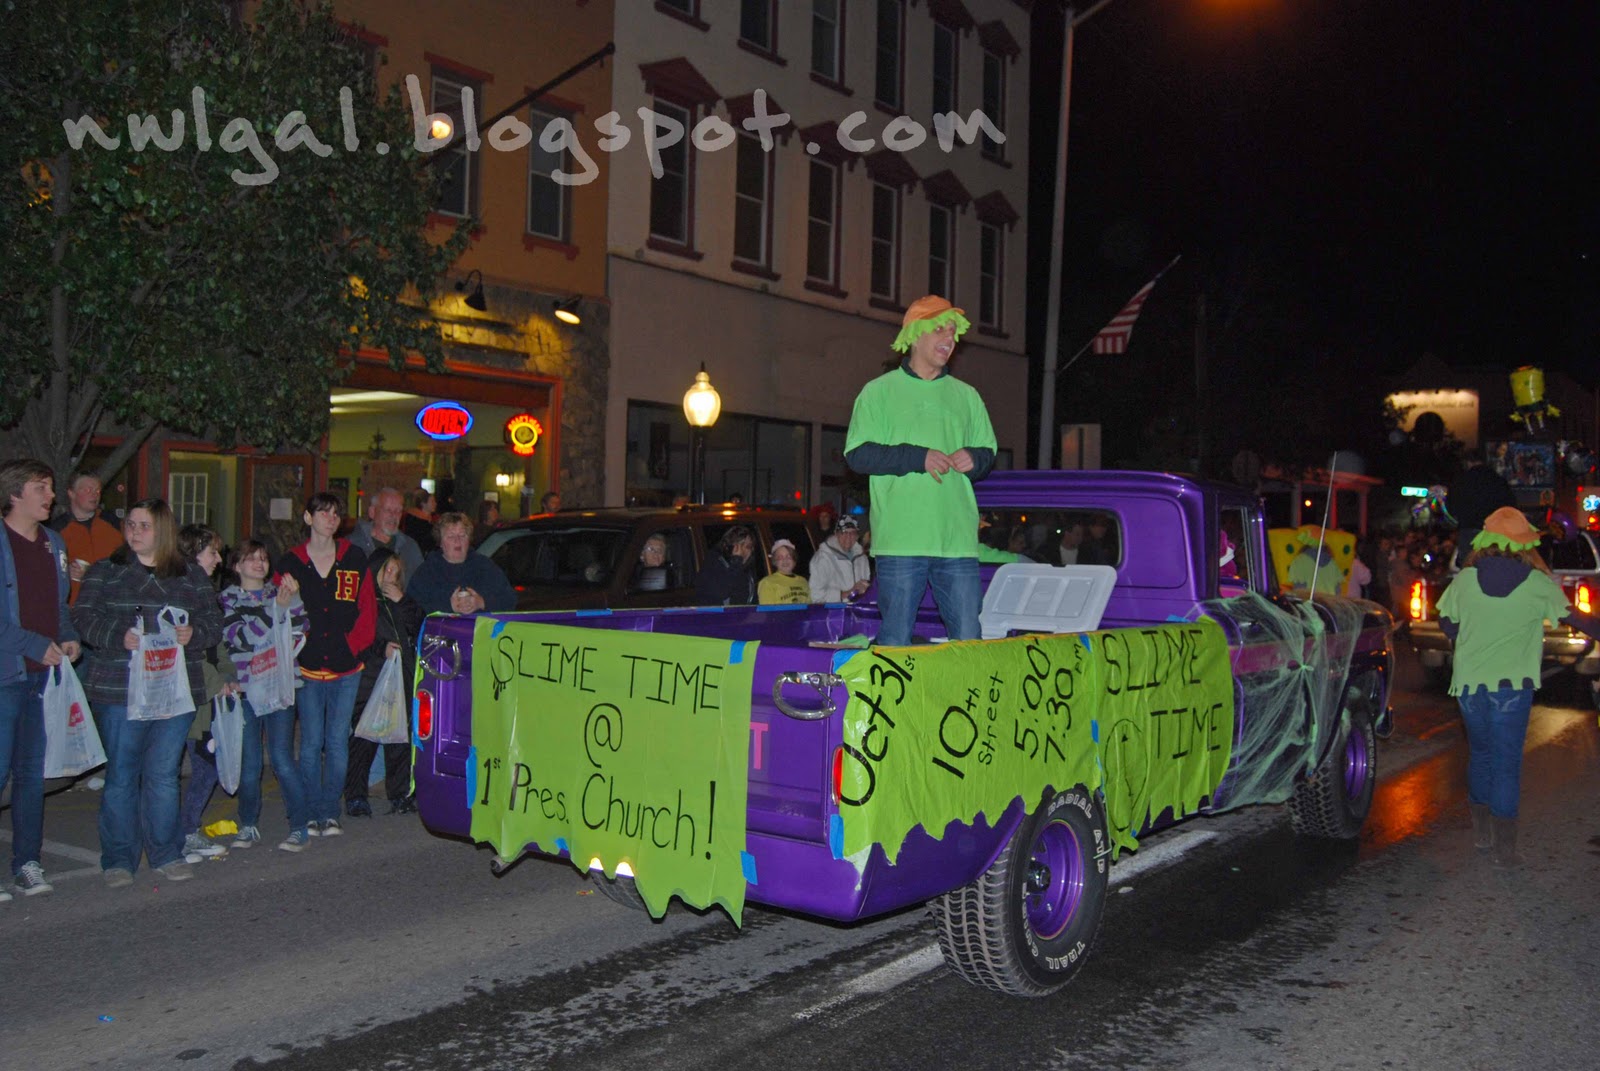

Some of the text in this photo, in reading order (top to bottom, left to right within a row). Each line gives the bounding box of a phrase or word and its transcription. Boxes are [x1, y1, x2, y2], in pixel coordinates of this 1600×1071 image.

[335, 569, 360, 602] H
[490, 635, 724, 714] SLIME TIME
[1101, 629, 1203, 696] SLIME
[584, 702, 623, 768] @
[931, 670, 1004, 780] 10th Street
[1150, 702, 1223, 760] TIME
[481, 757, 716, 861] 1st Pres. Church!
[1048, 793, 1093, 819] RADIAL
[1045, 940, 1086, 970] TRAIL
